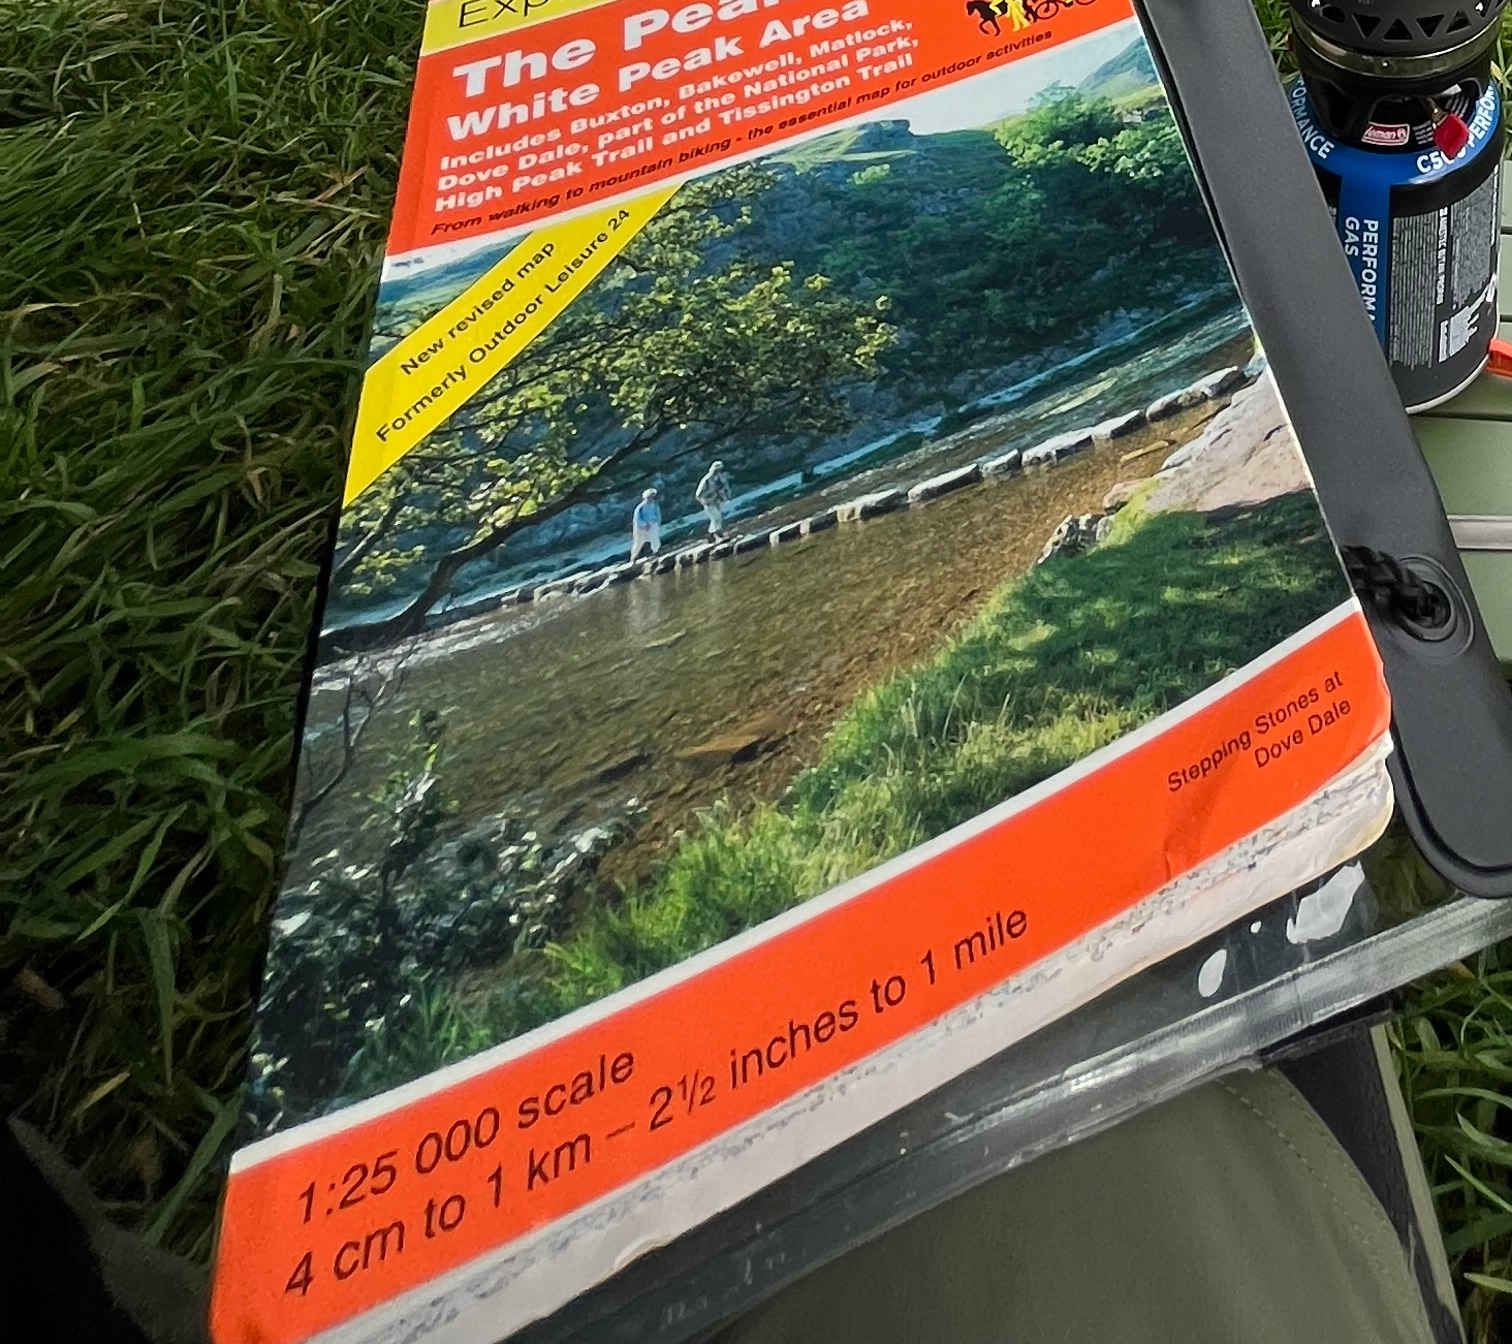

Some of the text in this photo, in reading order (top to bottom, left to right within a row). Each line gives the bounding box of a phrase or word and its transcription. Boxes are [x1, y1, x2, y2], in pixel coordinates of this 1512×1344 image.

[430, 215, 482, 236] From
[488, 194, 561, 221] walking
[566, 185, 584, 199] to
[589, 157, 673, 191] mountain
[678, 137, 731, 164] biking
[747, 121, 775, 141] the
[778, 96, 852, 130] essential
[855, 86, 891, 107] map
[895, 77, 917, 93] for
[921, 54, 982, 84] outdoor
[985, 30, 1053, 62] activities
[434, 53, 914, 213] High Peak Trail and Tissington Trail
[437, 36, 920, 192] Dove Dale, part of the National Park,
[439, 17, 913, 171] Includes Buxton, Bakewell, Matlock,
[447, 82, 601, 142] White
[617, 35, 745, 93] Peak
[452, 38, 597, 99] The
[400, 241, 556, 376] New revised map
[1344, 216, 1360, 257] GAS
[375, 209, 631, 443] Formerly Outdoor Leisure 24
[1167, 670, 1344, 793] Stepping Stones at
[1254, 697, 1352, 769] Dove Dale
[284, 1251, 315, 1297] 4
[333, 1219, 405, 1282] cm
[423, 1193, 466, 1240] to
[486, 1164, 503, 1209] 1
[526, 1132, 592, 1192] km
[729, 999, 859, 1090] inches
[869, 975, 907, 1013] to
[920, 948, 936, 986] 1
[953, 909, 1029, 971] mile
[297, 1050, 635, 1225] 1:25 000 scale
